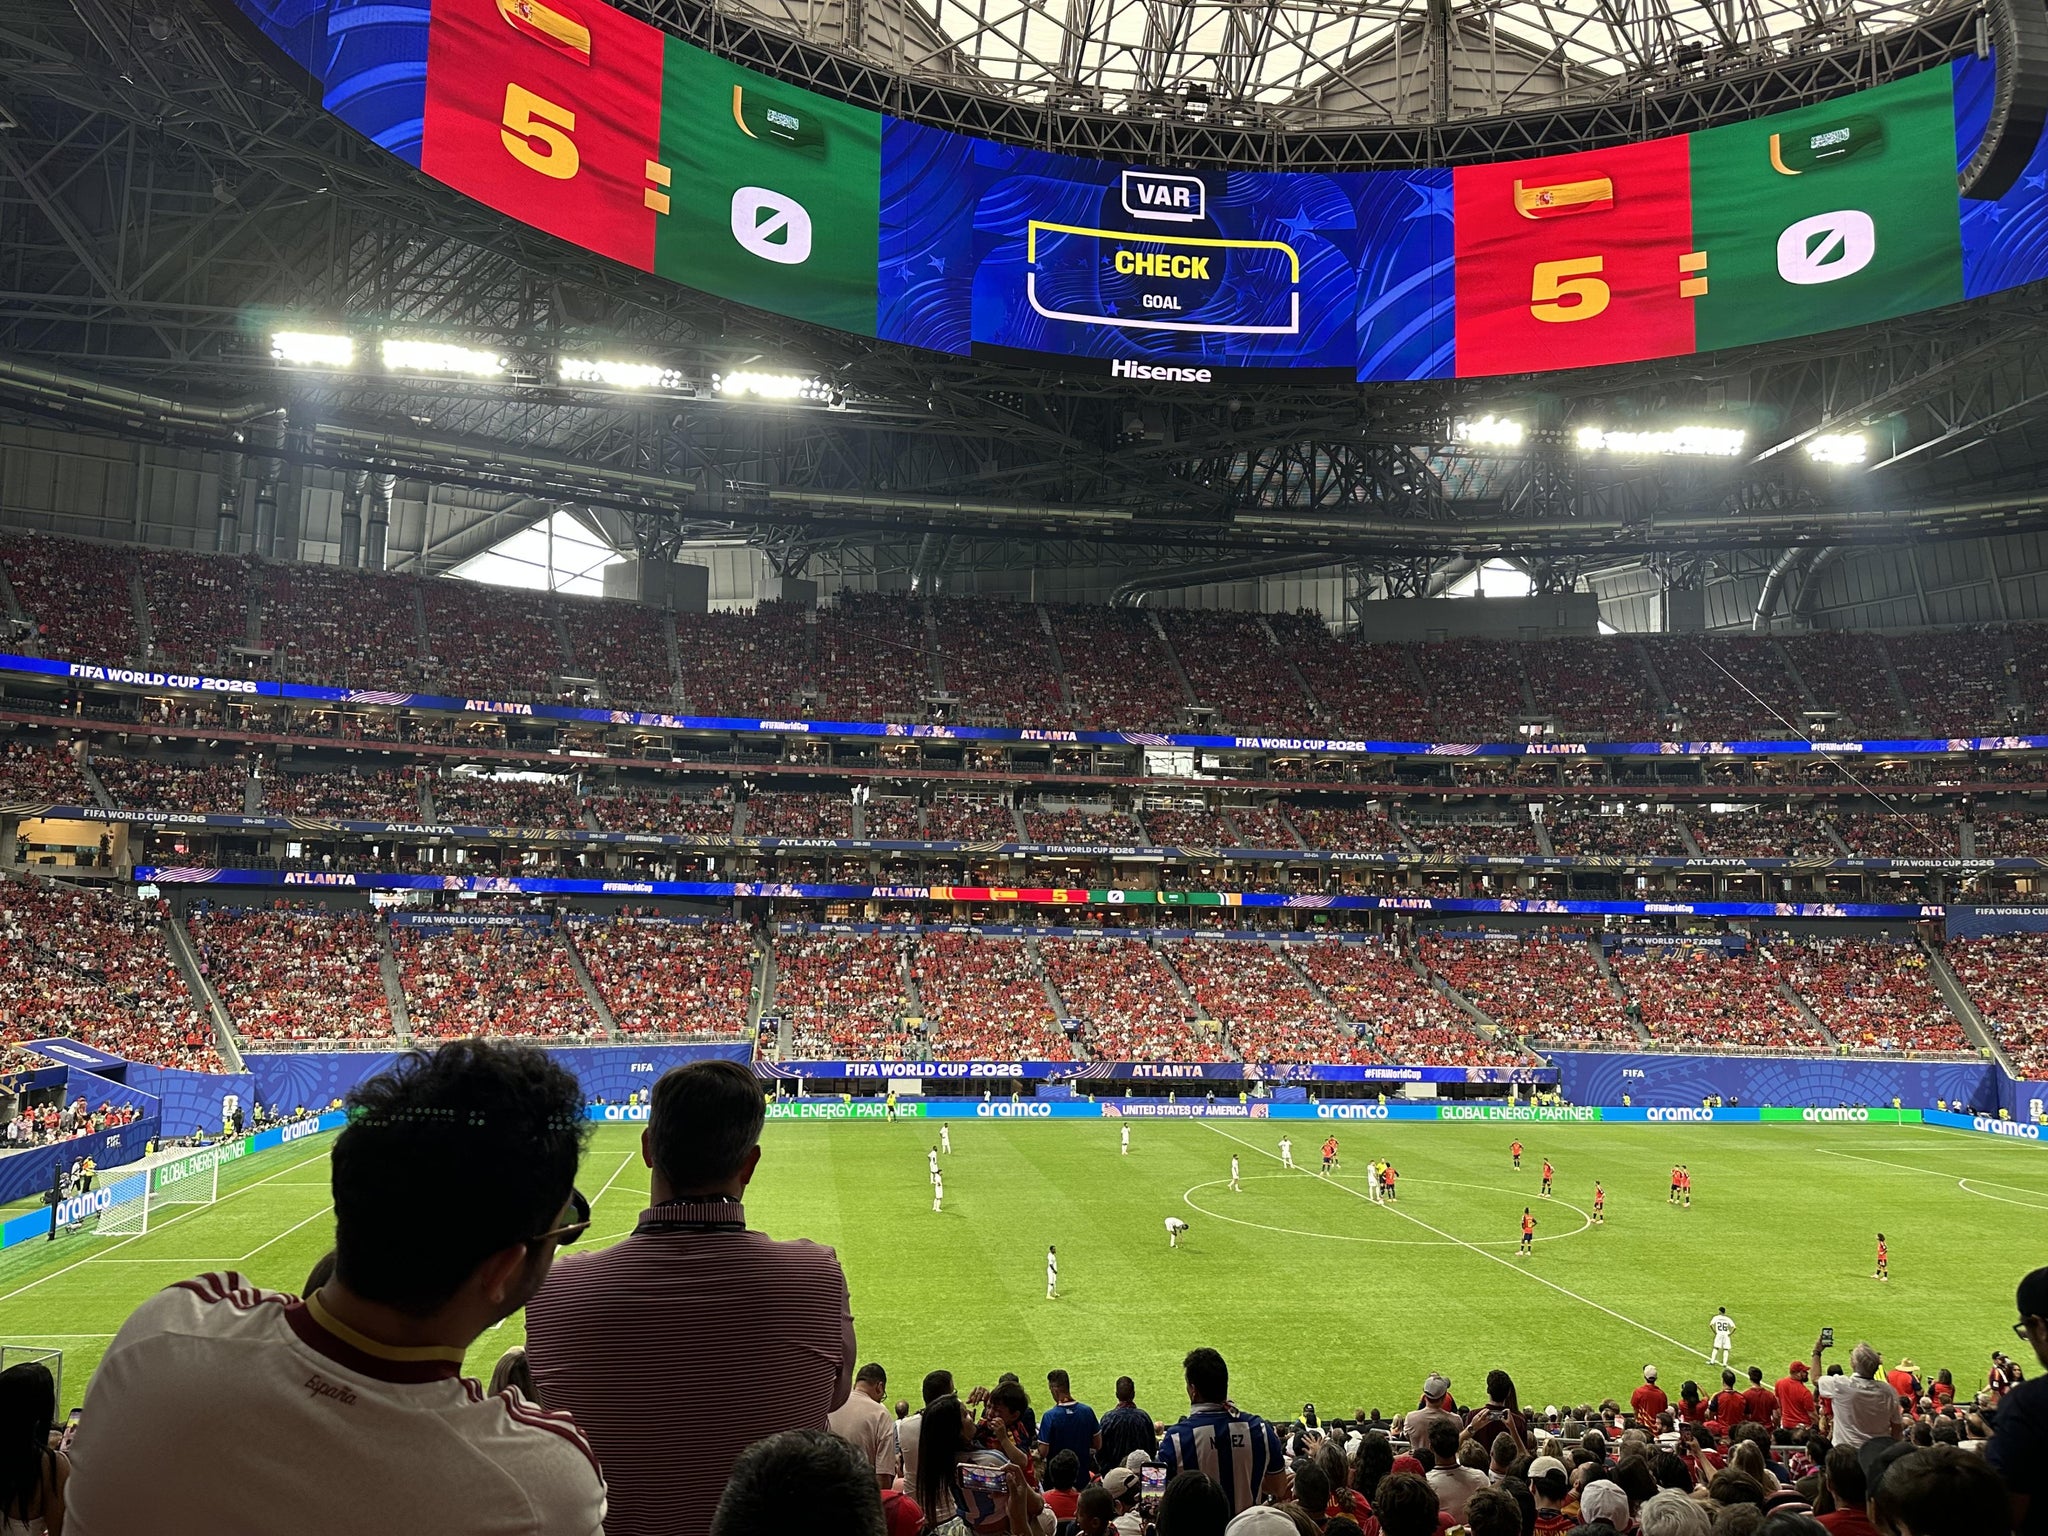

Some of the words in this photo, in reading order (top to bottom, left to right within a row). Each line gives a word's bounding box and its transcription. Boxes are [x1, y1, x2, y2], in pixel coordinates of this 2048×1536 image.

[501, 82, 580, 179] 5
[731, 186, 812, 264] 0
[1136, 183, 1190, 208] VAR
[1114, 250, 1210, 280] CHECK
[1530, 255, 1610, 323] 5
[1777, 210, 1875, 285] 0
[1142, 294, 1182, 310] GOAL
[1111, 359, 1212, 383] Hisense
[70, 664, 104, 680] FIFA
[107, 667, 165, 686] WORLD
[167, 674, 200, 689] CUP
[201, 678, 257, 693] 2026
[464, 699, 532, 715] ATLANTA
[759, 720, 809, 732] #FIFAWorldCup
[1020, 729, 1078, 742] ATLANTA
[1235, 737, 1260, 748] FIFA
[1261, 737, 1301, 750] WORLD
[1303, 739, 1326, 750] CUP
[1326, 741, 1366, 751] 2026
[1525, 744, 1587, 754] ATLANTA
[1811, 743, 1863, 752] #FIFAWorldCup
[83, 809, 105, 818] FIFA
[107, 810, 145, 820] WORLD
[146, 813, 168, 822] CUP
[169, 814, 207, 823] 2026
[385, 823, 455, 834] ATLANTA
[778, 838, 838, 847] ATLANTA
[1046, 845, 1063, 853] FIFA
[1064, 846, 1091, 854] WORLD
[1330, 853, 1384, 861] ATLANTA
[1686, 858, 1747, 866] ATLANTA
[1891, 859, 1910, 867] FIFA
[1942, 859, 1962, 867] CUP
[1962, 859, 1996, 867] 2026
[284, 872, 357, 886] ATLANTA
[602, 882, 653, 893] #FIFAWorldCup
[871, 887, 929, 898] ATLANTA
[1052, 889, 1069, 903] 5
[1378, 898, 1433, 909] ATLANTA
[1644, 904, 1694, 914] #FIFAWorldCup
[412, 915, 432, 924] FIFA
[433, 916, 467, 925] WORLD
[468, 916, 487, 925] CUP
[631, 1063, 654, 1072] FIFA
[845, 1063, 876, 1076] FIFA
[880, 1063, 936, 1076] WORLD
[938, 1063, 969, 1076] CUP
[970, 1063, 1023, 1076] 2026
[1132, 1064, 1203, 1077] ATLANTA
[1364, 1068, 1422, 1081] #FIFAWorldCup
[1622, 1069, 1645, 1078] FIFA
[604, 1104, 651, 1120] ara
[764, 1103, 798, 1118] OBAL
[801, 1103, 855, 1118] ENERGY
[976, 1102, 1052, 1117] aramco
[1122, 1105, 1156, 1115] UNITED
[1157, 1105, 1191, 1115] STATES
[1191, 1105, 1205, 1115] OF
[1205, 1105, 1249, 1116] AMERICA
[1317, 1104, 1389, 1119] aramco
[1441, 1107, 1487, 1120] GLOBAL
[1489, 1107, 1537, 1120] ENERGY
[1538, 1107, 1594, 1121] PARTNER
[1646, 1107, 1714, 1121] aramco
[1803, 1108, 1868, 1122] aramco
[281, 1118, 319, 1142] aramco
[1973, 1117, 2039, 1139] aramco
[160, 1159, 188, 1186] GLOBAL
[188, 1151, 215, 1174] ENERGY
[217, 1140, 246, 1163] PARTNER
[56, 1187, 111, 1226] aramco
[1717, 1321, 1728, 1332] 26
[304, 1374, 358, 1406] España
[1209, 1434, 1245, 1450] NEZ
